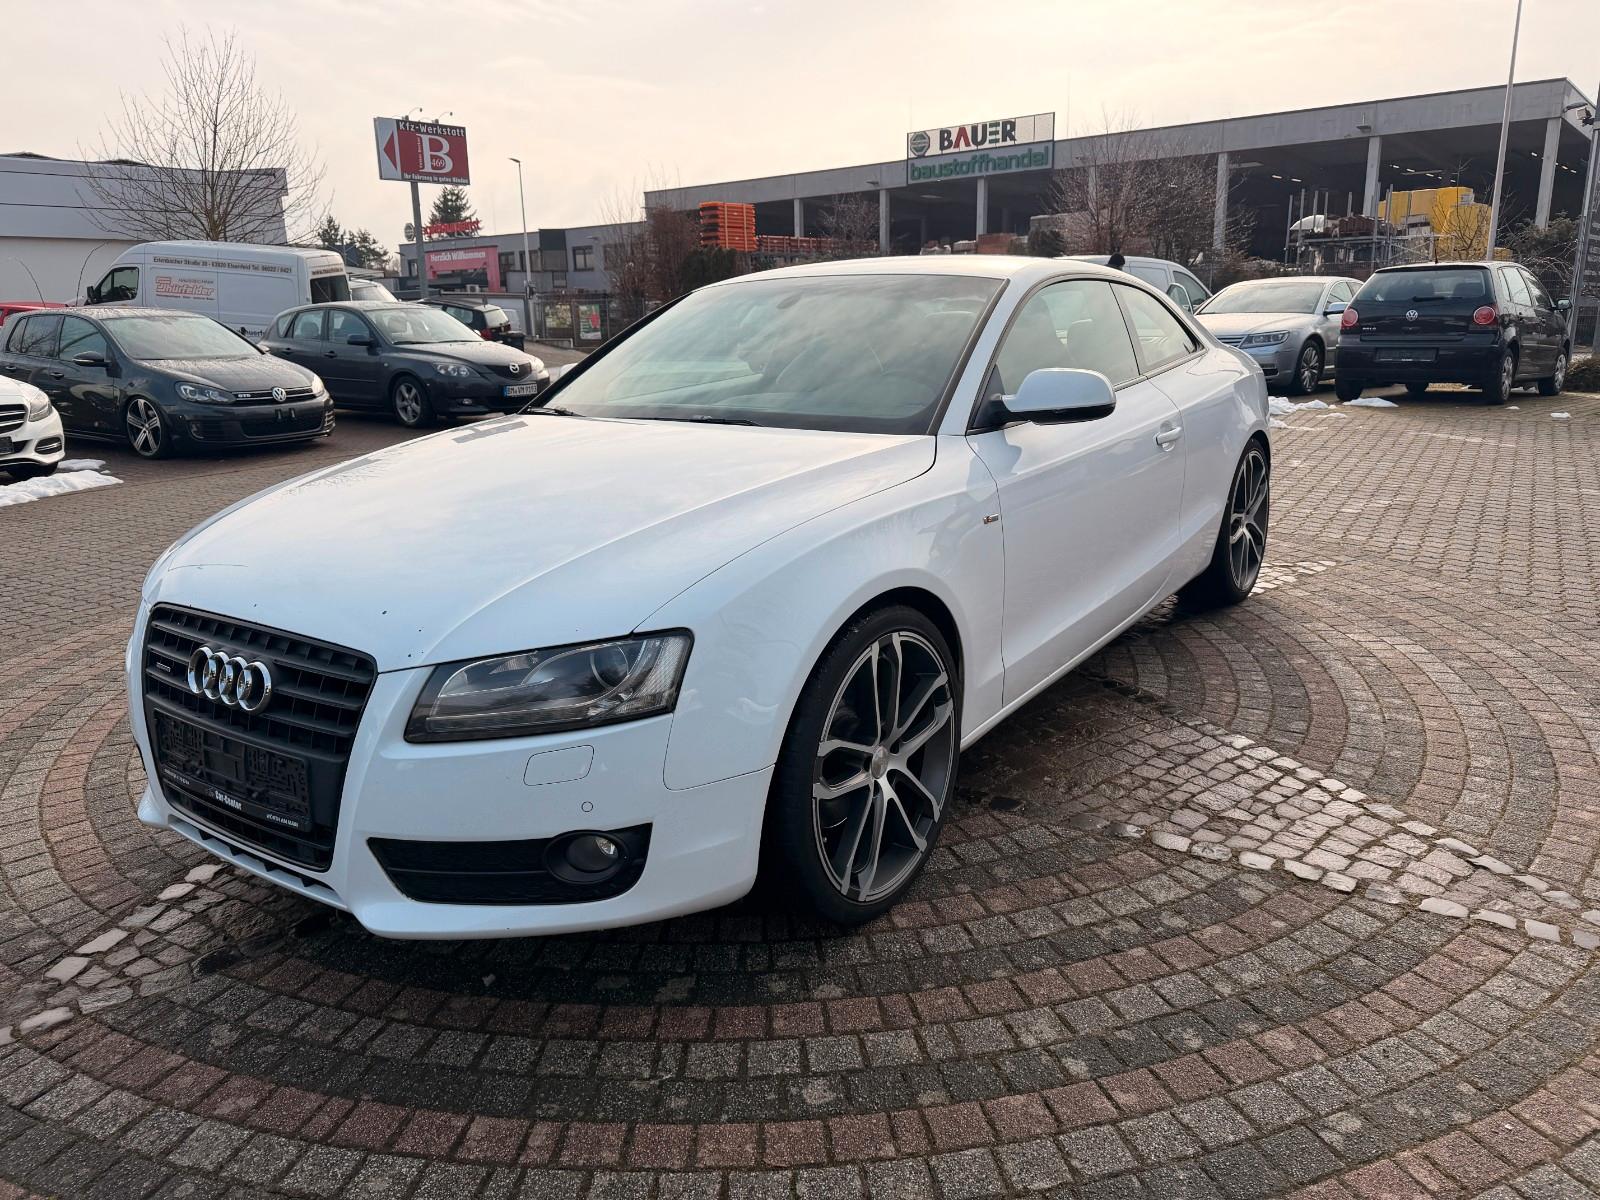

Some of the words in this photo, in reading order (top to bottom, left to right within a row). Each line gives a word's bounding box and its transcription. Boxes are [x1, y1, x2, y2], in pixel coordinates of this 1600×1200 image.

[399, 121, 465, 137] Kfz-Werkstatt
[939, 120, 1016, 150] BAUER
[416, 133, 453, 174] B
[910, 145, 1049, 181] baustoffhandel
[431, 253, 451, 262] Herzlich
